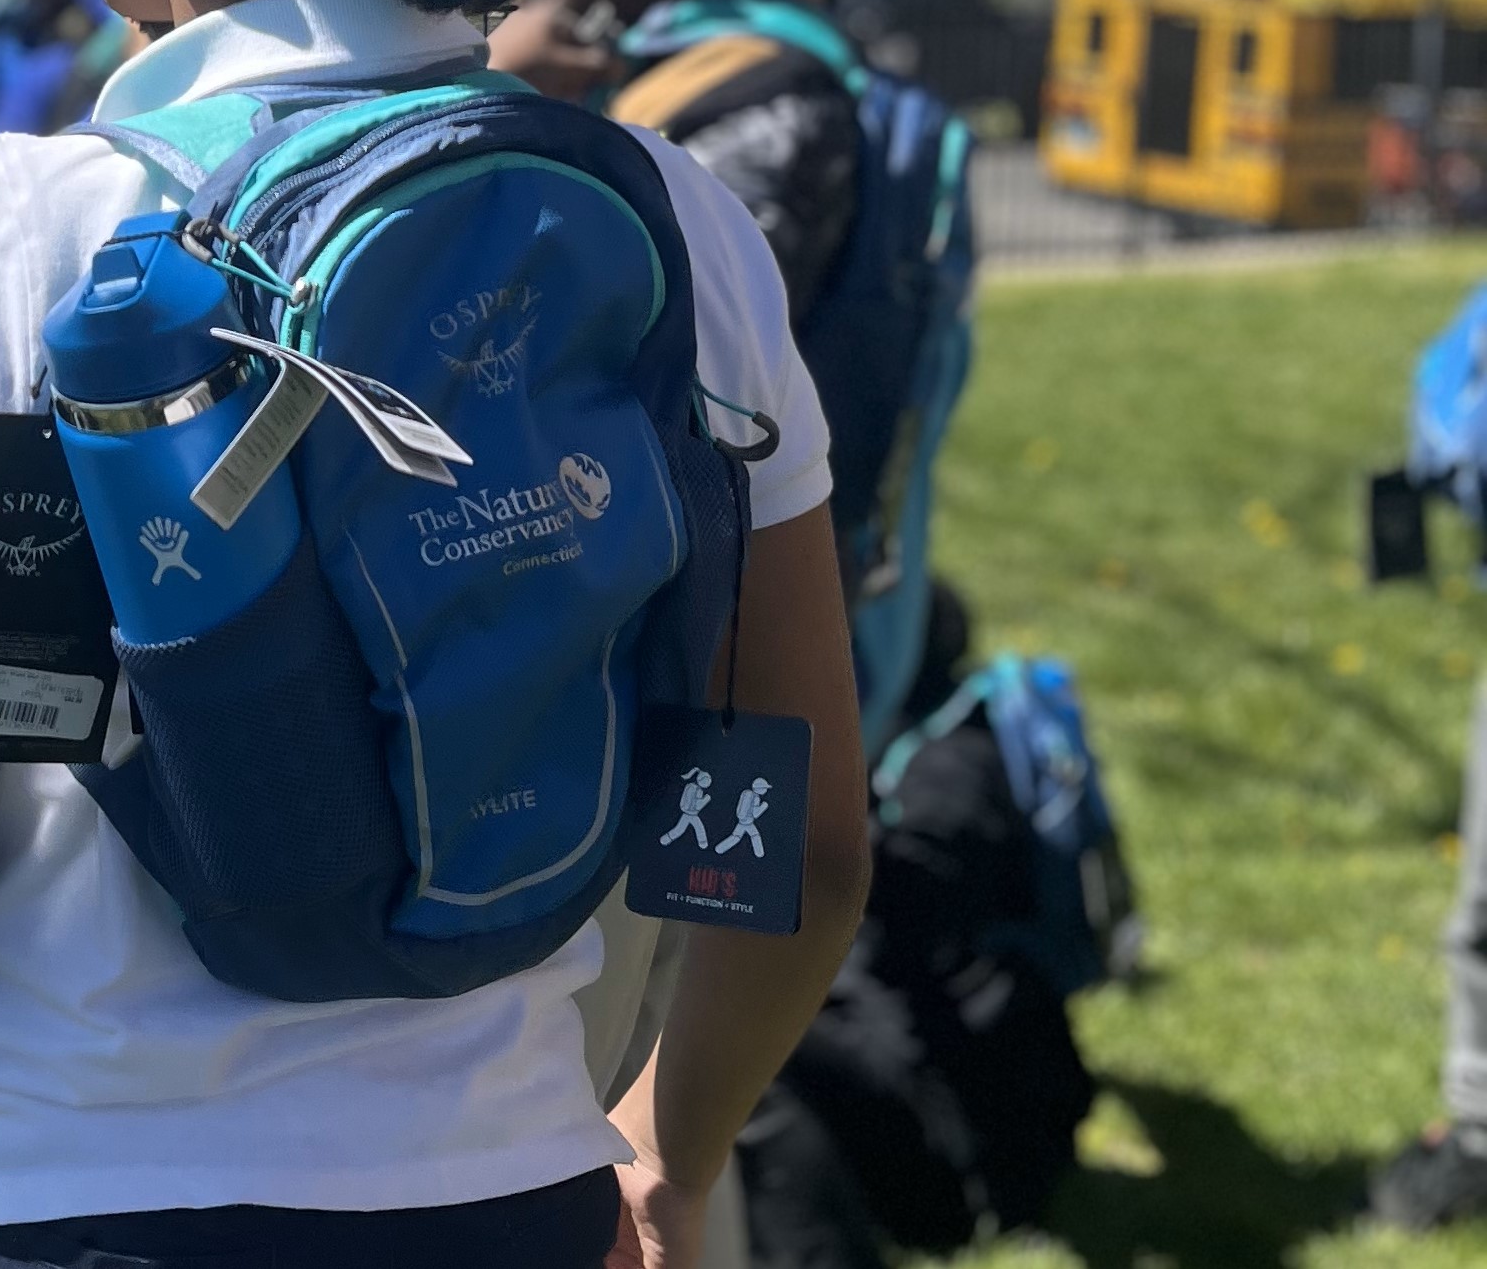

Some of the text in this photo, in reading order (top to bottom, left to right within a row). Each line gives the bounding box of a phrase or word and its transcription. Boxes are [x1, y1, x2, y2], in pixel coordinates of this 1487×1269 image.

[429, 286, 543, 340] OSPY
[408, 480, 564, 537] The Natur
[420, 506, 575, 568] Conservancy
[685, 894, 724, 909] FUNCTION
